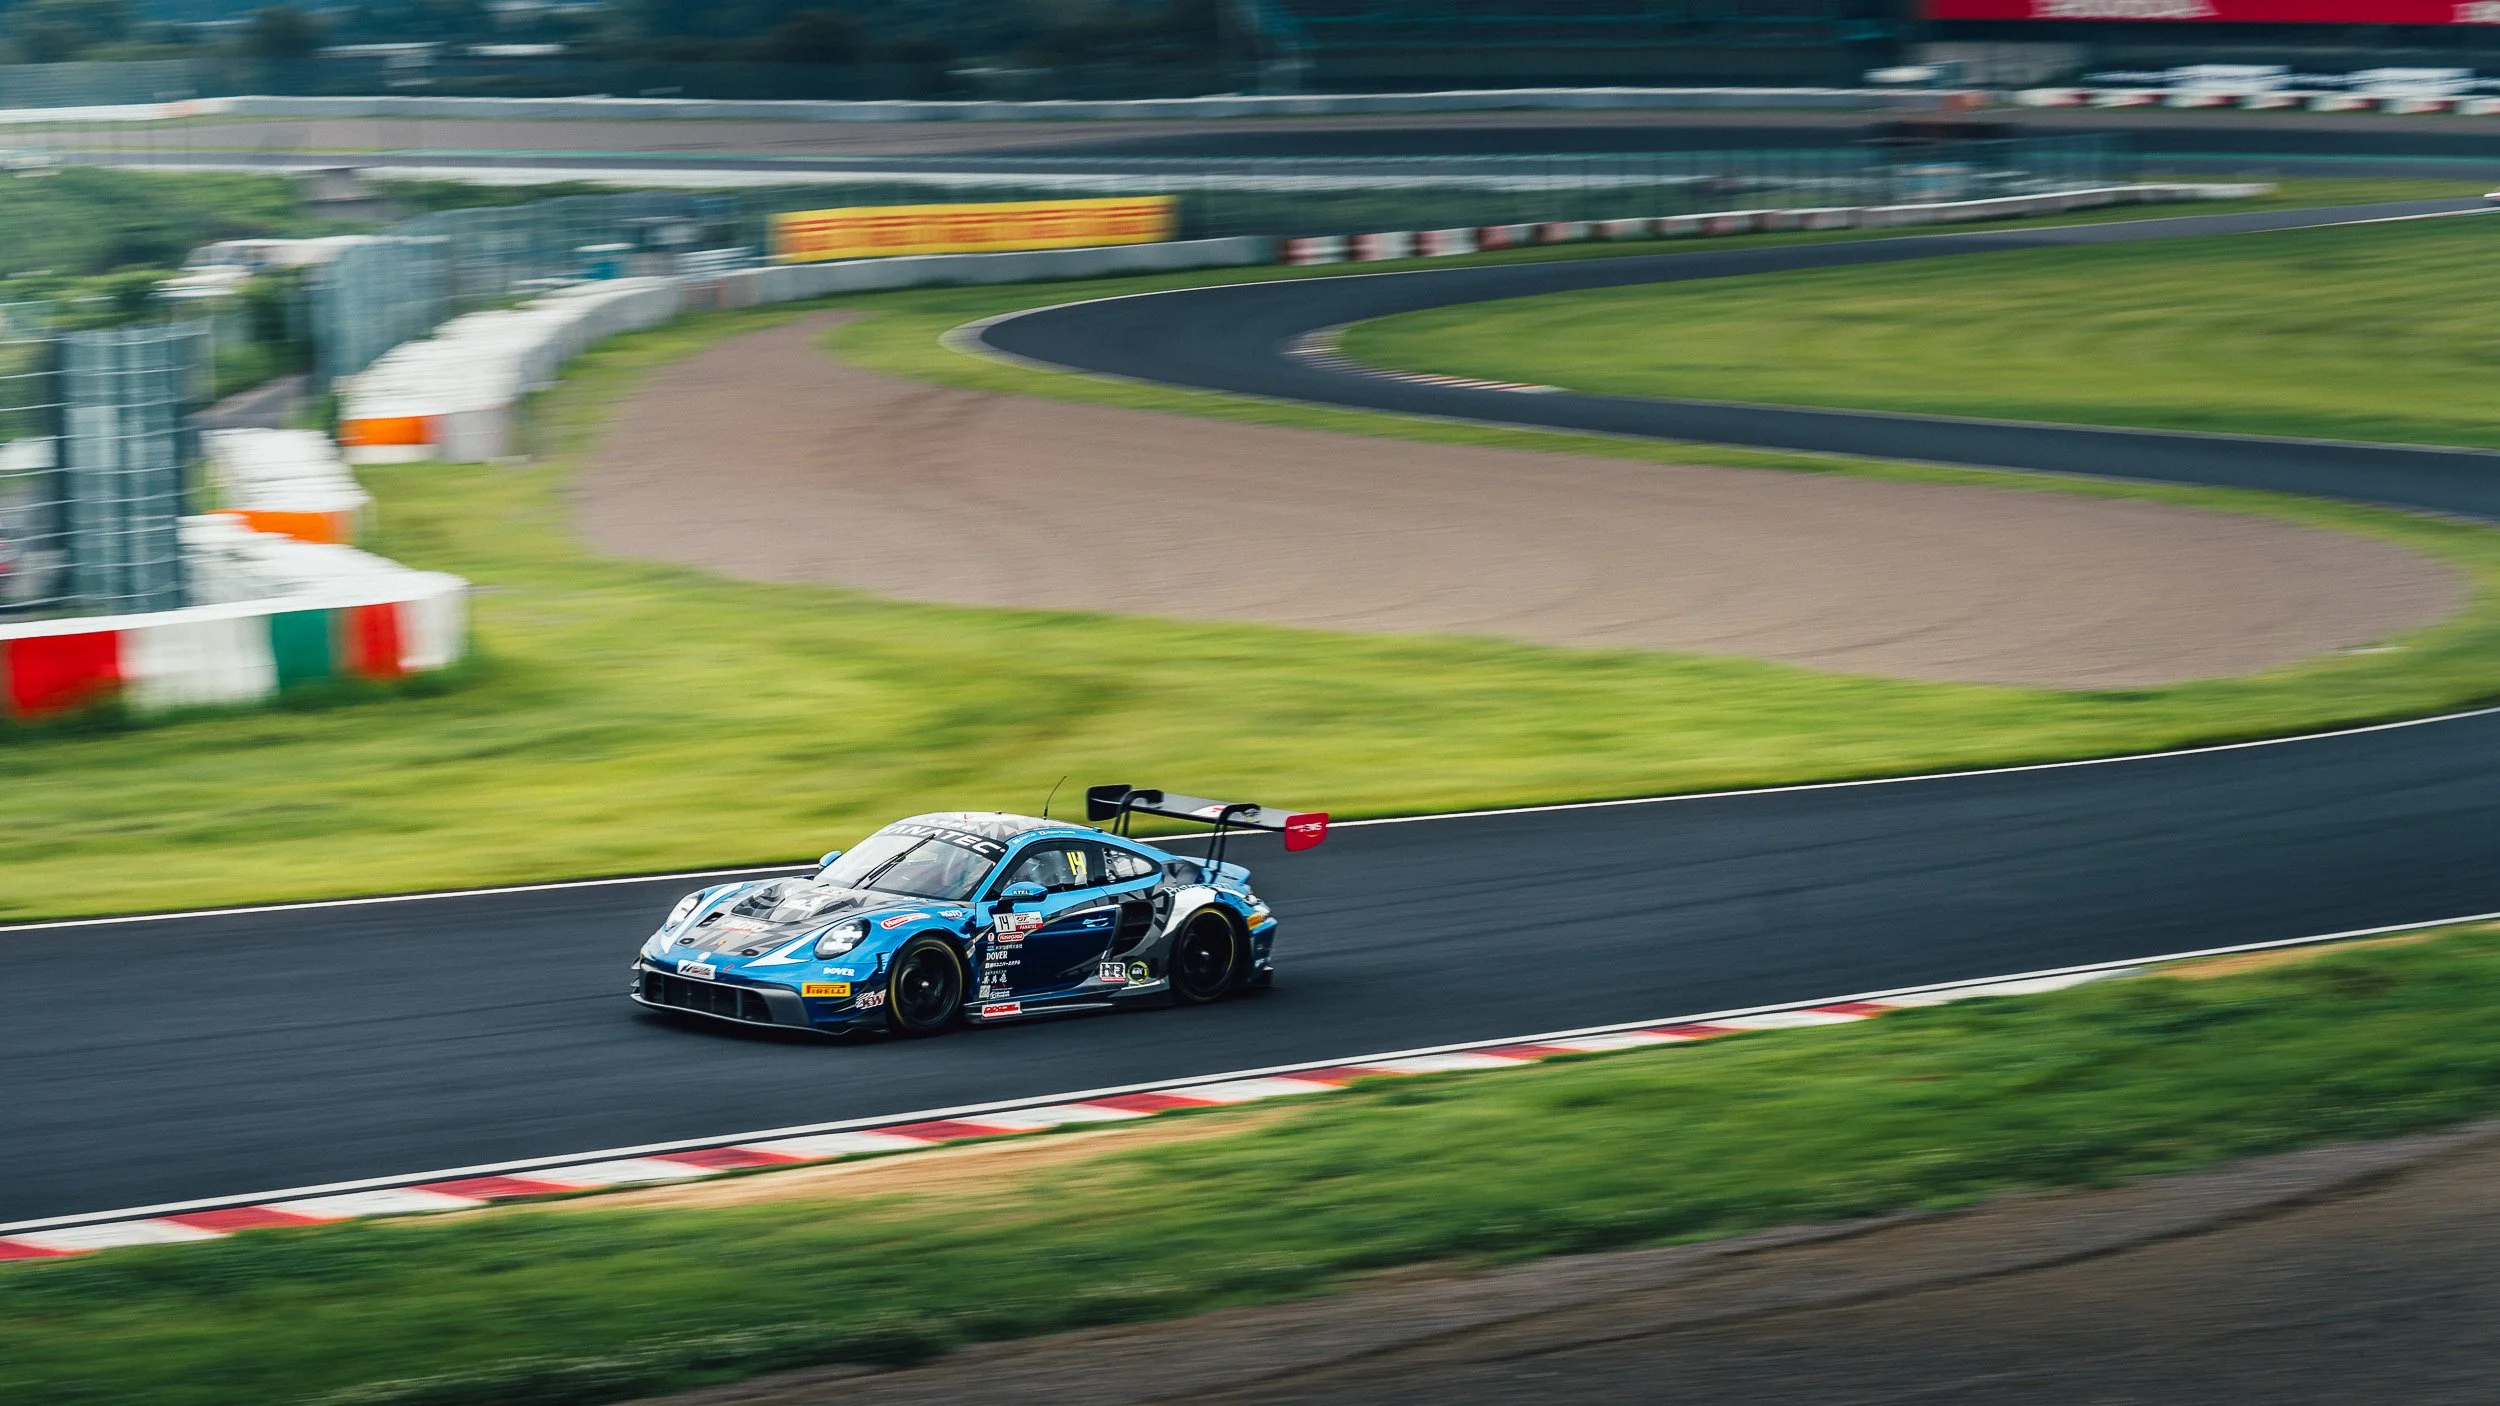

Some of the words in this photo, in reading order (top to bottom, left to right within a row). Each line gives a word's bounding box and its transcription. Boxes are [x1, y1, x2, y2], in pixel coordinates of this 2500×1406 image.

[1066, 851, 1088, 876] 14
[998, 915, 1010, 931] 14
[986, 951, 1008, 961] DOVER
[823, 967, 855, 977] DOVER
[806, 984, 846, 994] PIRELLI
